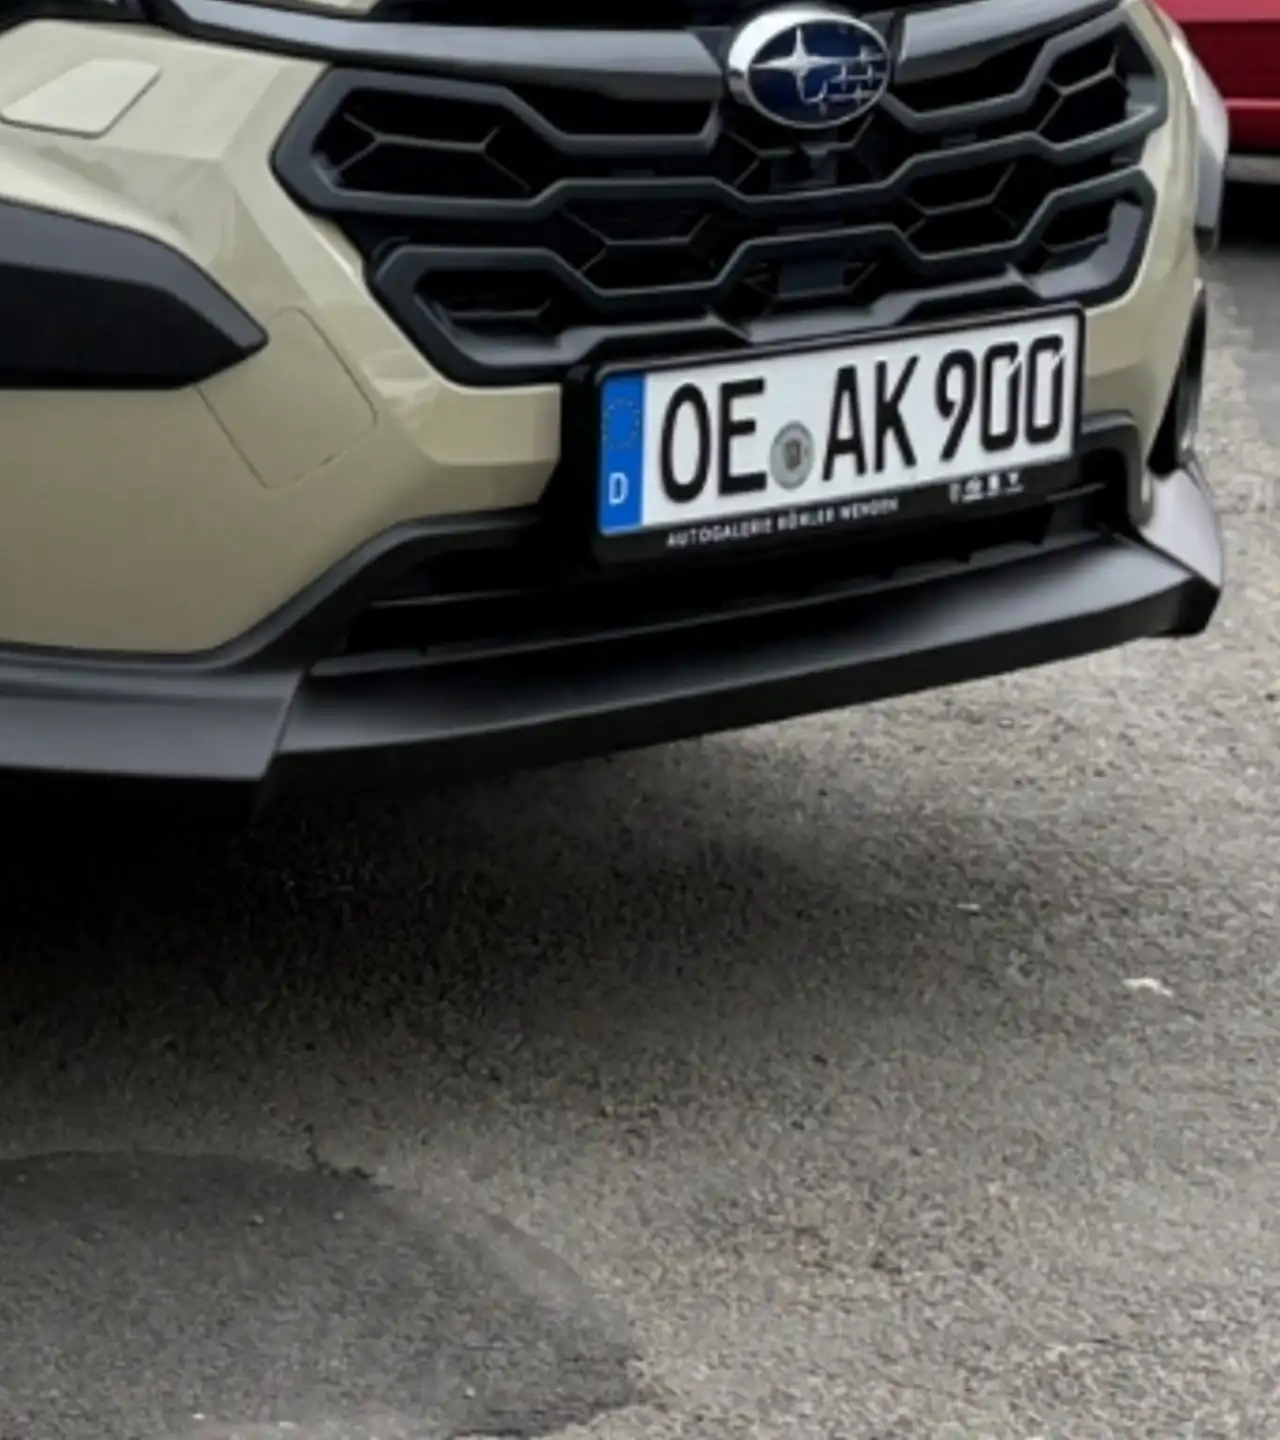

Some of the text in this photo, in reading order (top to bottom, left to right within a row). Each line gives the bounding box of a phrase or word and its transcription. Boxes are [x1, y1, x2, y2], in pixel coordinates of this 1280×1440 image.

[659, 333, 1066, 504] OE AK 900
[607, 471, 630, 506] D
[666, 496, 900, 548] AUTOGALERIE KÖHLER WENDEN
